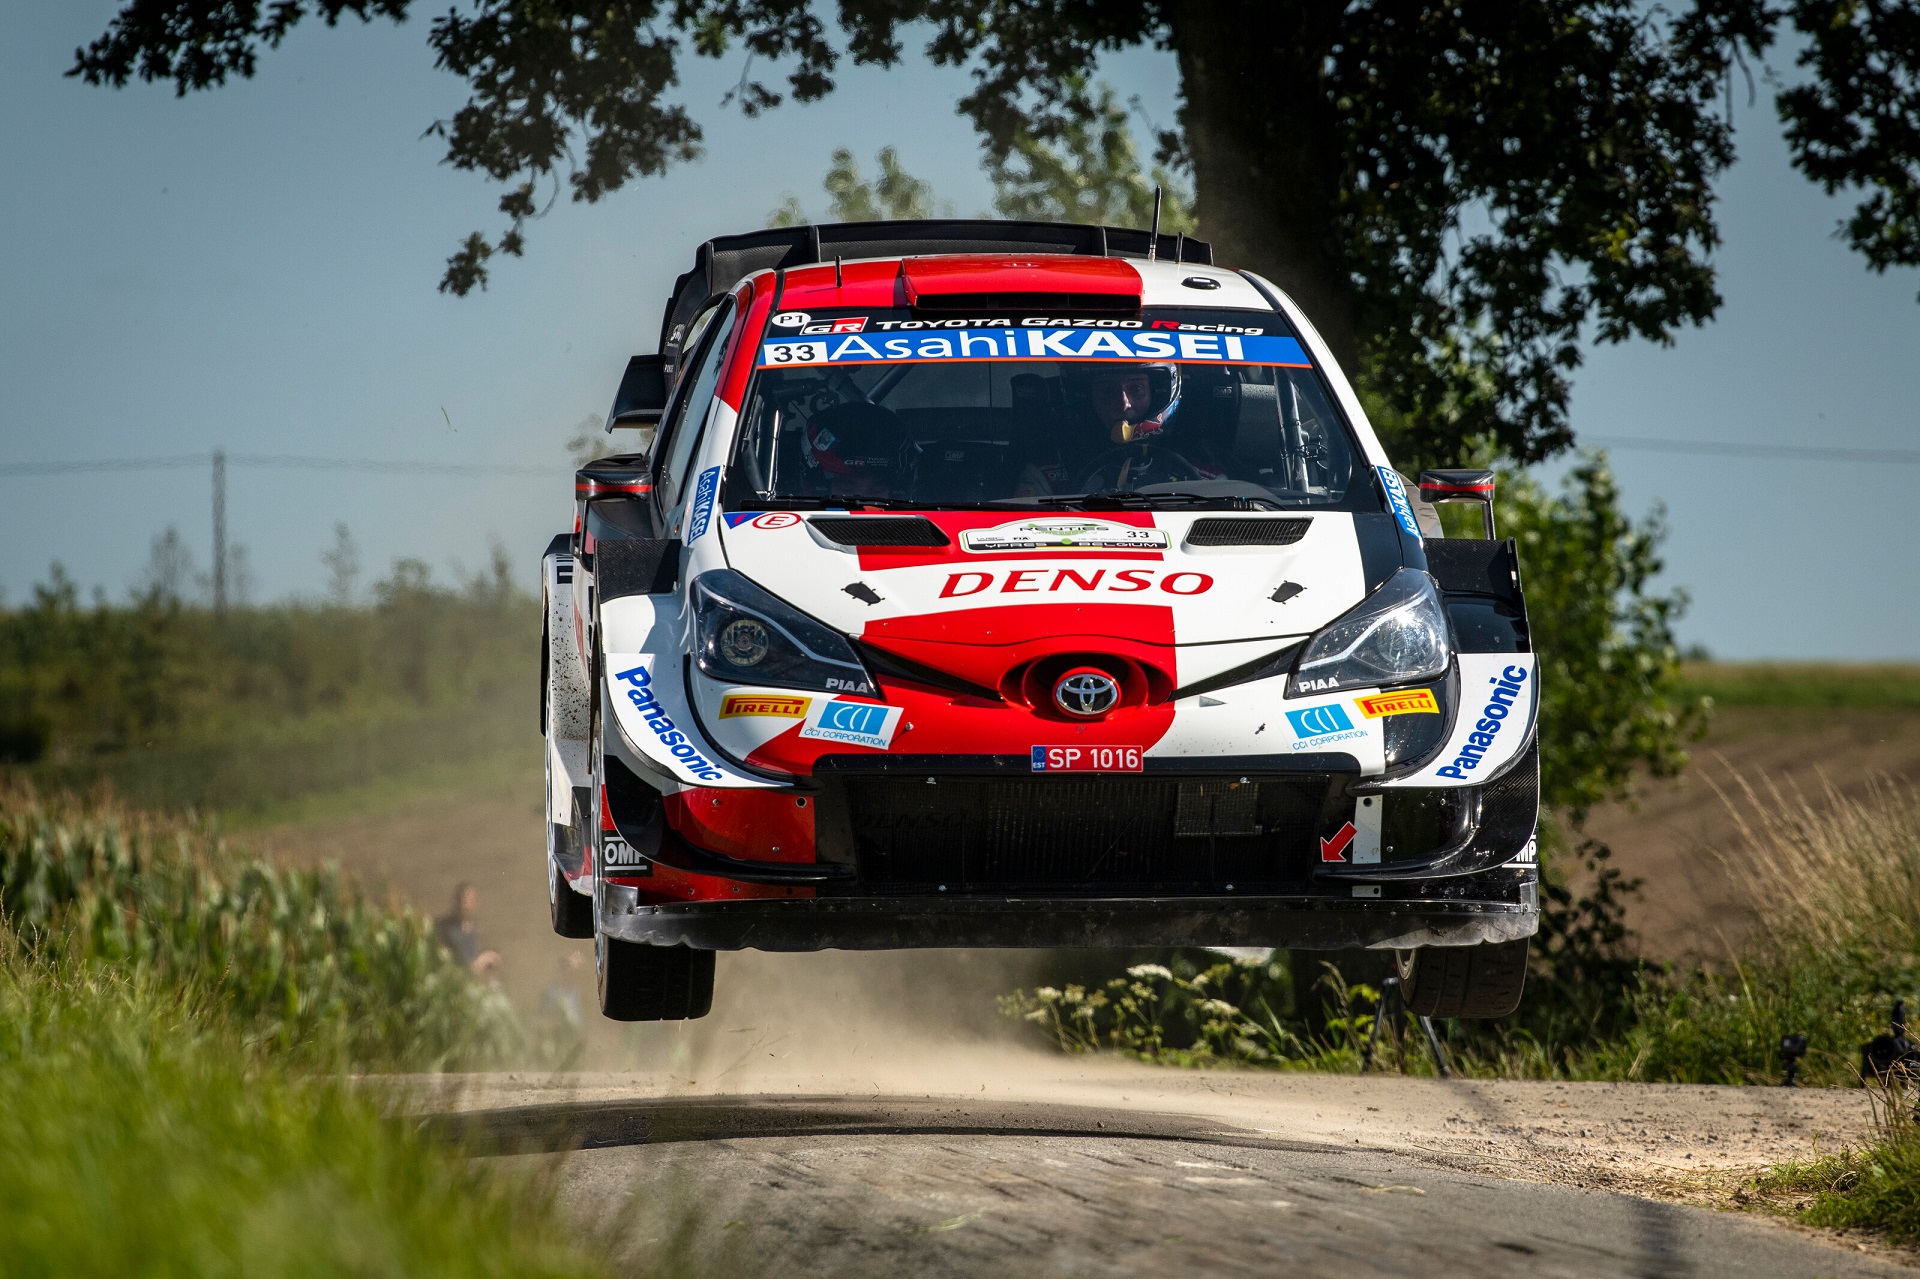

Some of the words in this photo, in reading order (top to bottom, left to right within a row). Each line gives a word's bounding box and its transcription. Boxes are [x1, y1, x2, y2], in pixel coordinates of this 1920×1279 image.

[779, 314, 803, 324] P1
[803, 322, 863, 333] GR
[876, 318, 1011, 329] TOYOTA
[1021, 317, 1143, 328] GAZOO
[1151, 320, 1264, 336] Racing
[773, 344, 815, 362] 33
[764, 515, 790, 525] E
[1126, 530, 1150, 538] 33
[938, 569, 1214, 598] DENSO
[825, 677, 868, 693] PIAA
[1298, 676, 1340, 692] PIAA
[725, 697, 805, 714] PIRELLI
[1361, 692, 1432, 715] PIRELLI
[615, 666, 722, 781] Panasonic
[1435, 664, 1527, 780] Panasonic
[804, 728, 820, 736] CCI
[822, 730, 886, 747] CORPORATION
[1292, 740, 1308, 750] CCI
[1310, 730, 1368, 747] CORPORATION
[1049, 748, 1081, 768] SP
[1090, 748, 1139, 768] 1016
[1515, 840, 1537, 862] MP
